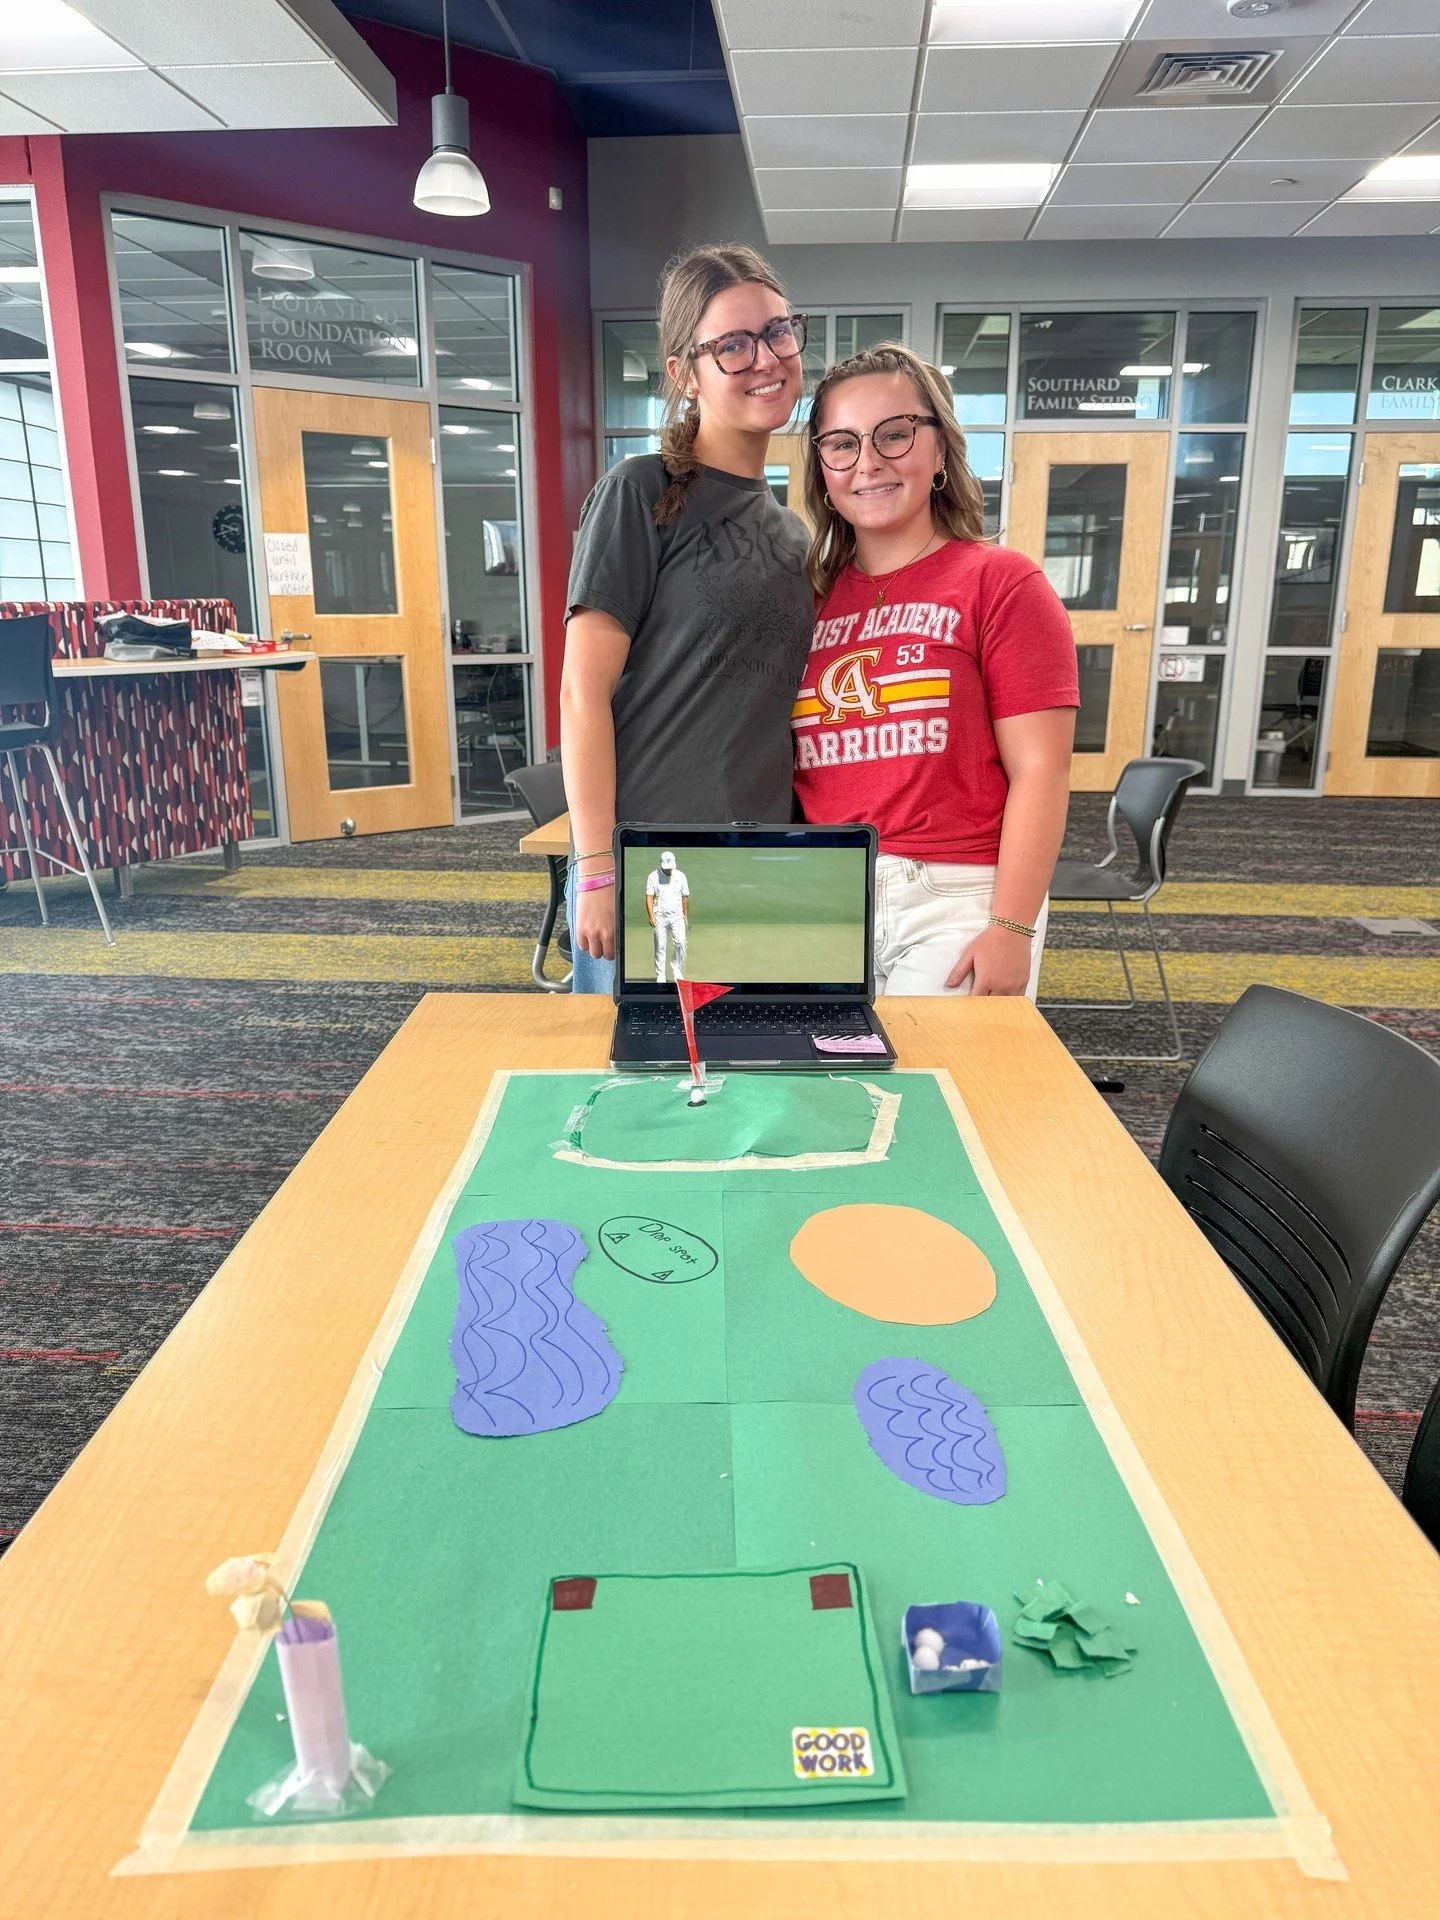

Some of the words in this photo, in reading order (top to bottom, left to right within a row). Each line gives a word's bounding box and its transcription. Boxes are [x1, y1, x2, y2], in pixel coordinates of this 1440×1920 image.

[259, 313, 408, 349] FOUNDATION
[260, 338, 333, 366] ROOM
[1026, 377, 1121, 392] SOUTHARD
[1381, 374, 1440, 391] CLARK
[1027, 395, 1086, 410] FAMILY
[811, 612, 862, 652] RIST
[857, 602, 963, 645] ACADEMY
[896, 643, 926, 666] 53
[794, 716, 950, 771] ARRIORS
[795, 1733, 866, 1752] GOOD
[798, 1752, 868, 1773] WORK
